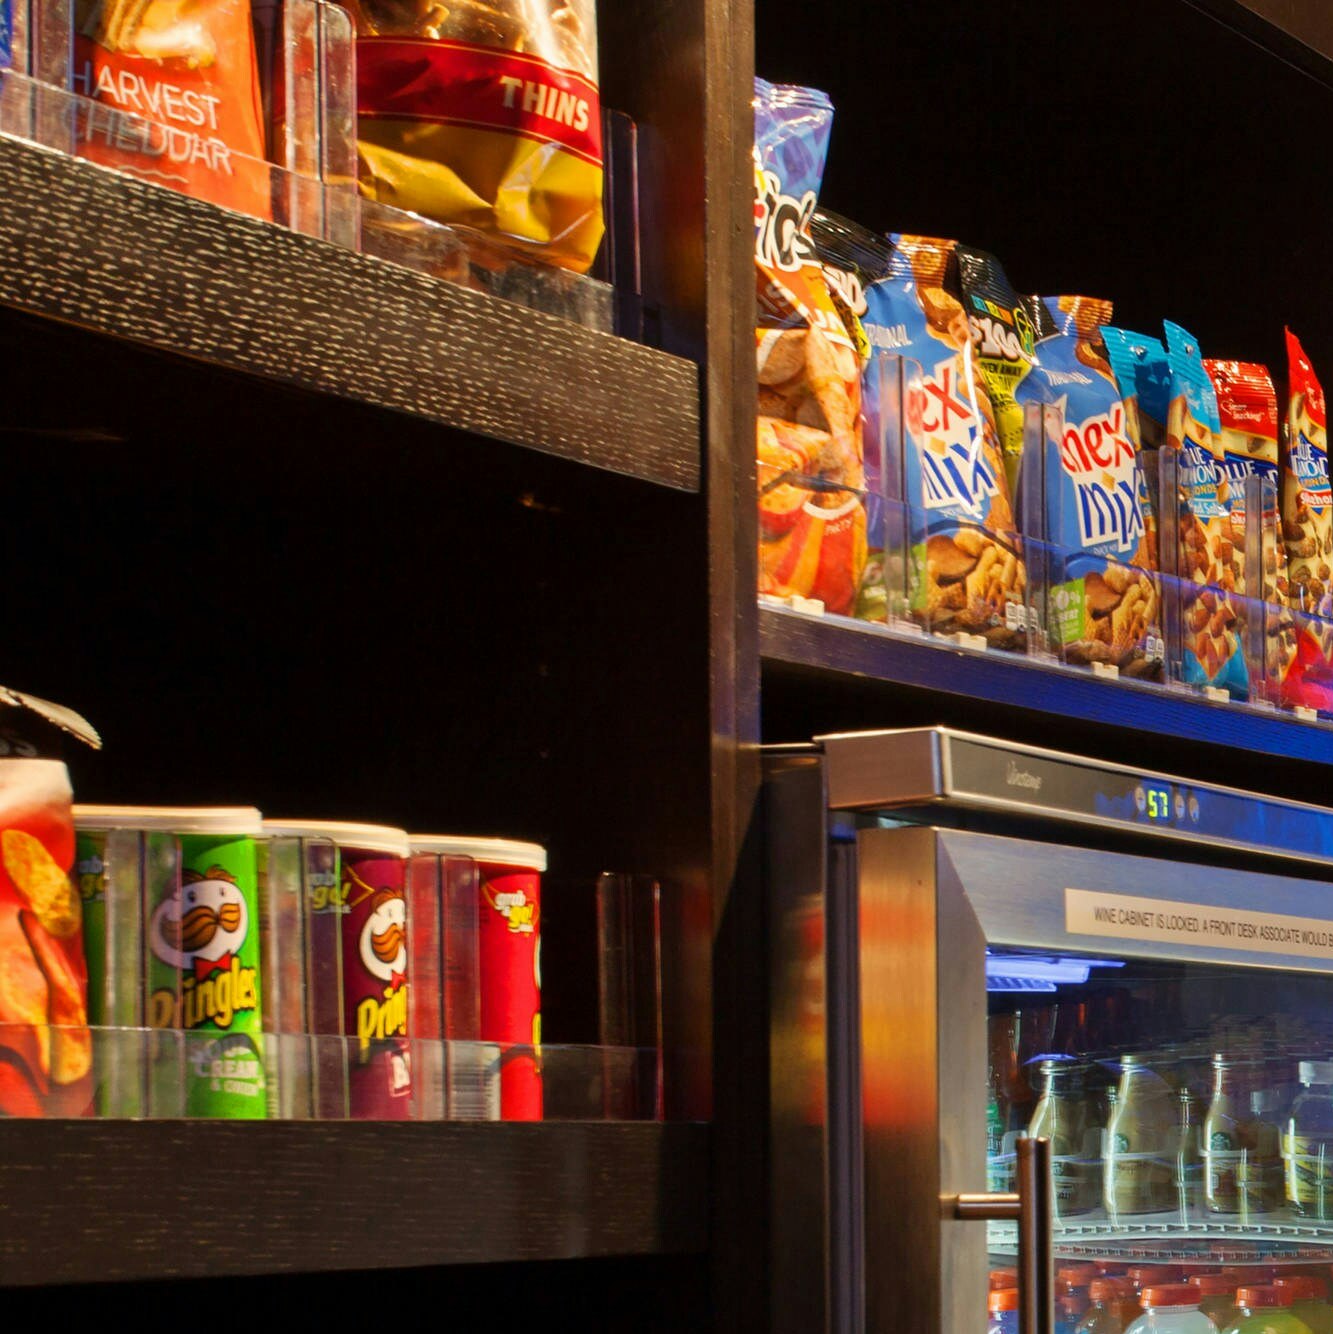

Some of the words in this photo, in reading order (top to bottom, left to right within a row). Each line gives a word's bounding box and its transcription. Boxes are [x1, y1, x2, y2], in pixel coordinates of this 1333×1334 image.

[500, 75, 590, 133] THINS
[1146, 789, 1169, 818] 57
[1094, 905, 1116, 923] WINE
[1118, 909, 1155, 928] CABINET
[1156, 913, 1165, 929] IS
[1202, 919, 1209, 933] A
[1210, 919, 1238, 936] FRONT
[1238, 922, 1258, 938] DESK
[1260, 925, 1301, 944] ASSOCIATE
[1301, 929, 1327, 947] WOULD
